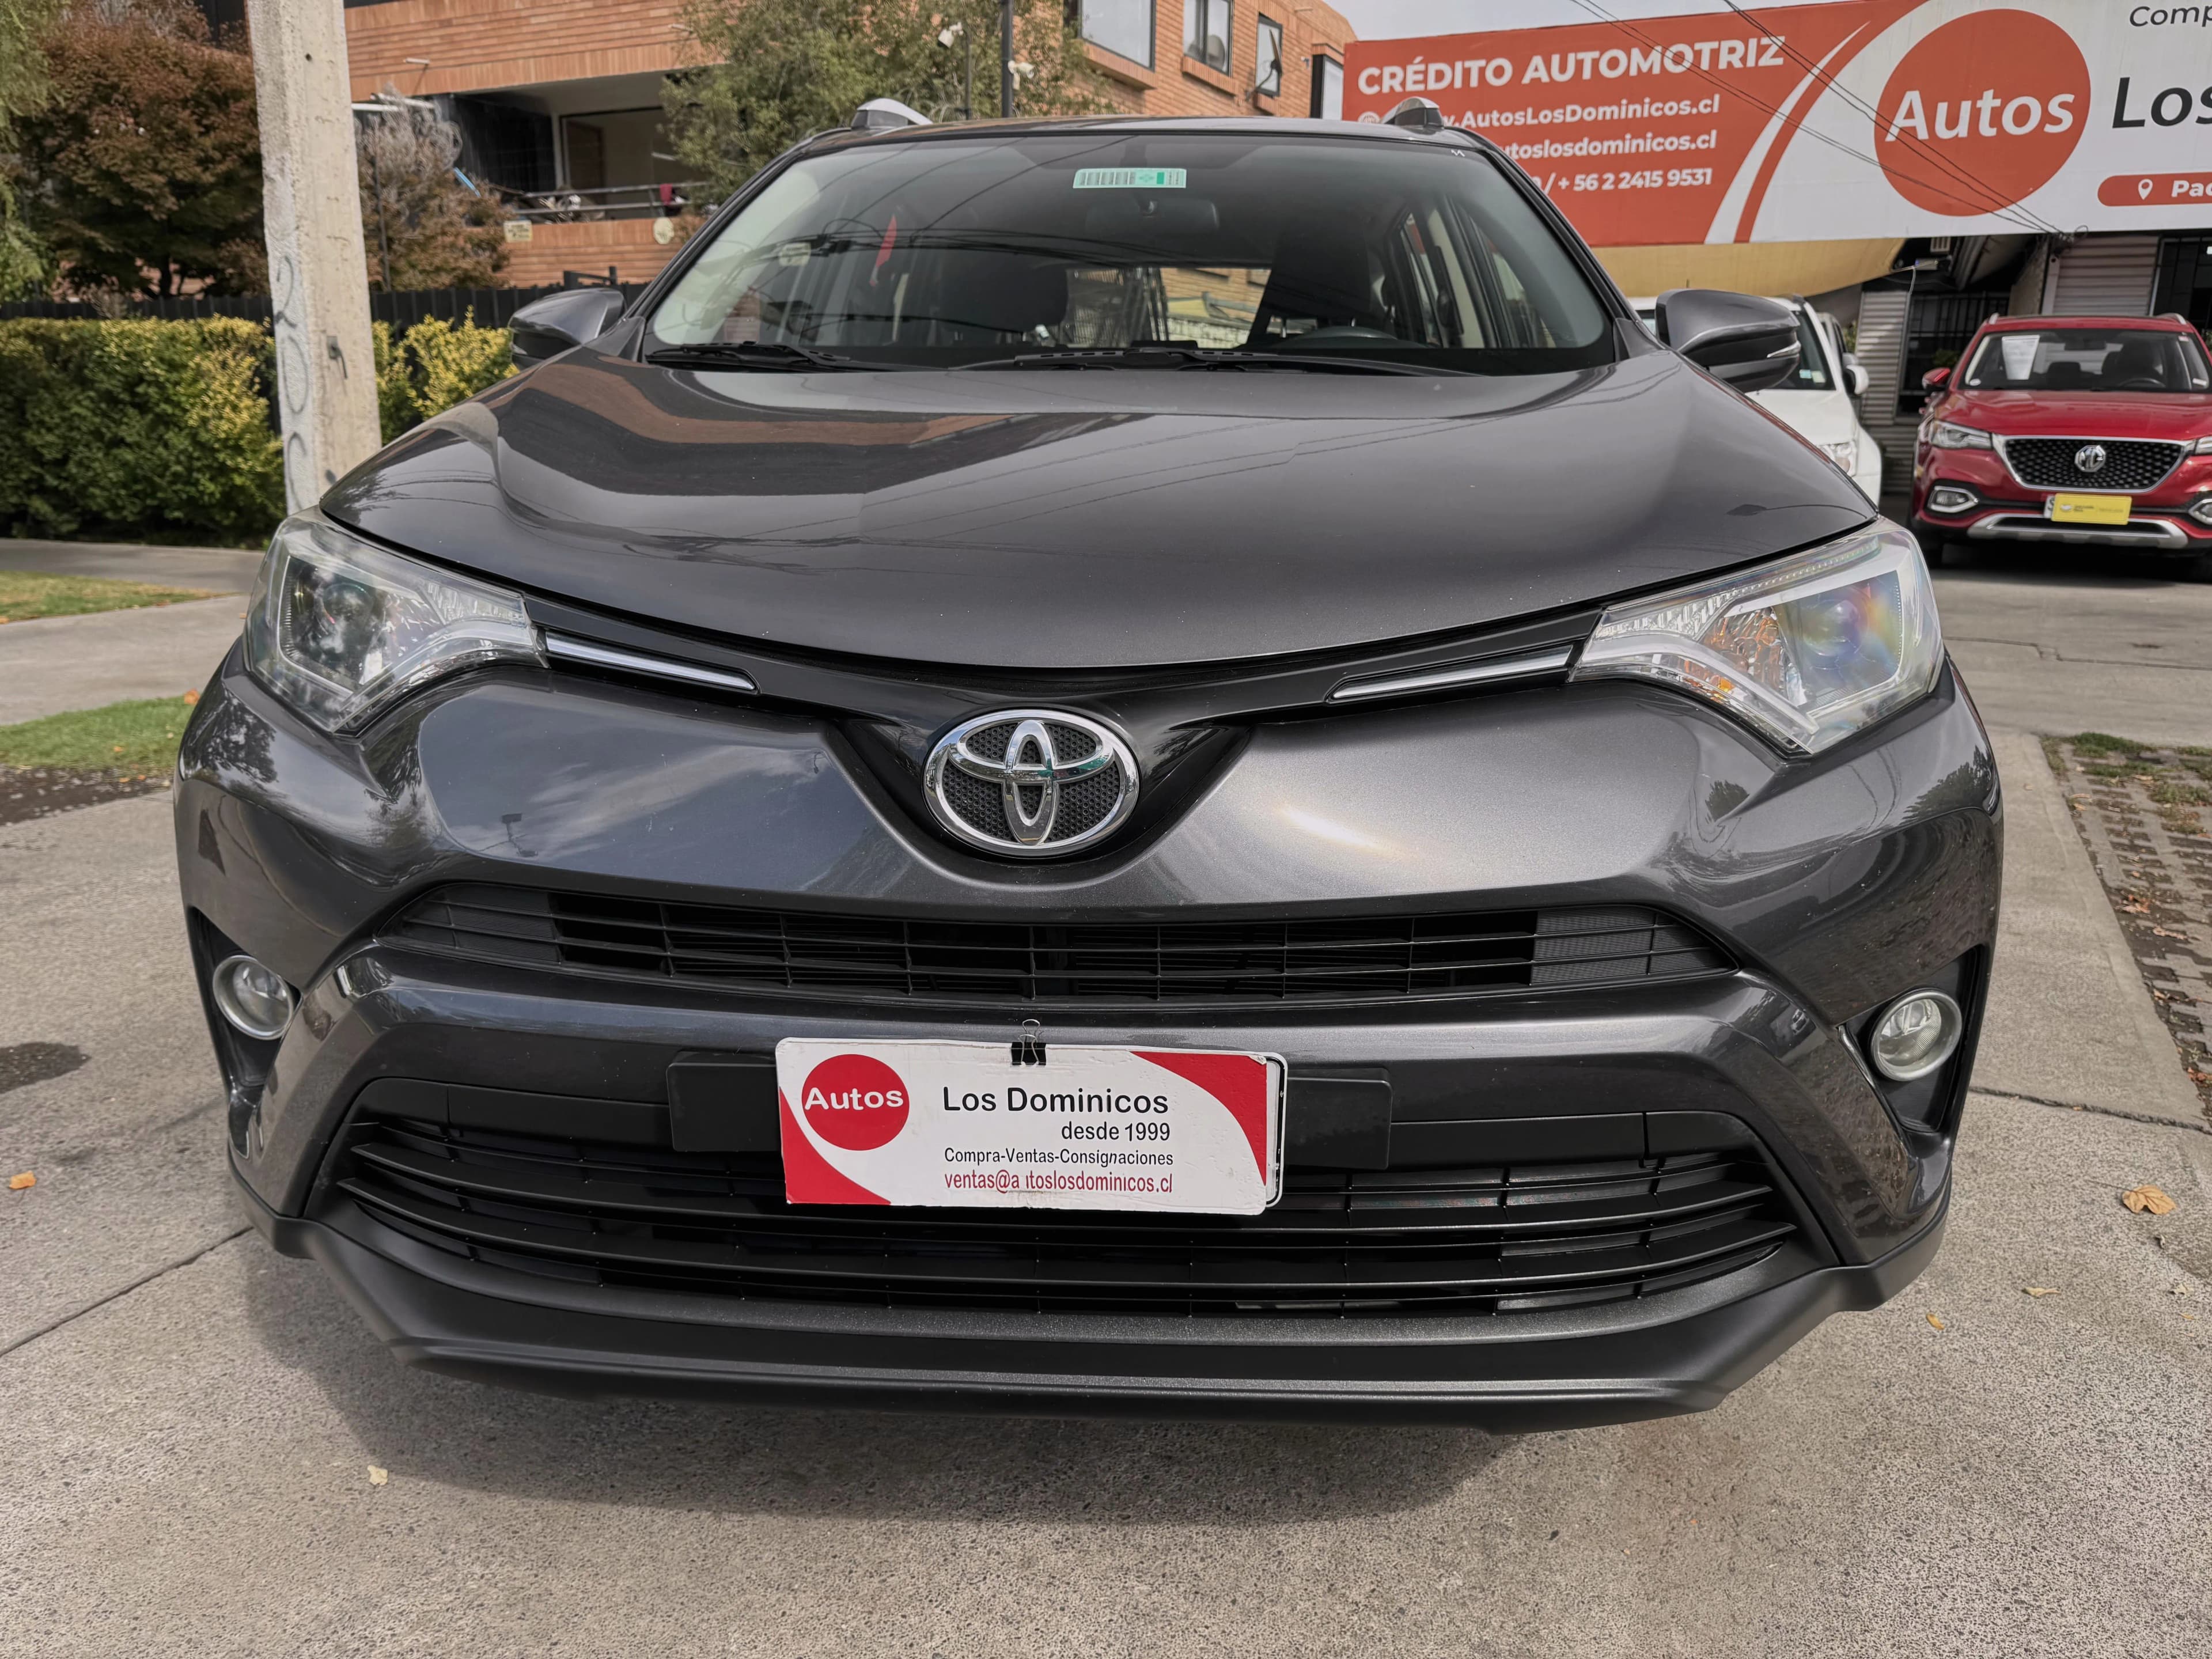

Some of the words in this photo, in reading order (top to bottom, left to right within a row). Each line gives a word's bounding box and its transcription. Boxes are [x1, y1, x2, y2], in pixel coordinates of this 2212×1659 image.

[1358, 56, 1513, 94] CRÉDITO
[1521, 35, 1785, 85] AUTOMOTRIZ
[2112, 77, 2212, 128] Los
[1885, 89, 2075, 142] Autos
[1573, 173, 1599, 191] 56
[1601, 172, 1615, 190] 2
[1618, 170, 1664, 190] 2415
[1667, 168, 1713, 187] 9531
[805, 1087, 904, 1111] Autos
[944, 1086, 997, 1111] Los
[1007, 1087, 1169, 1113] Dominicos
[1062, 1121, 1119, 1140] desde
[1124, 1122, 1171, 1142] 1999
[945, 1147, 1173, 1168] Compra-Ventas-Consignaciones
